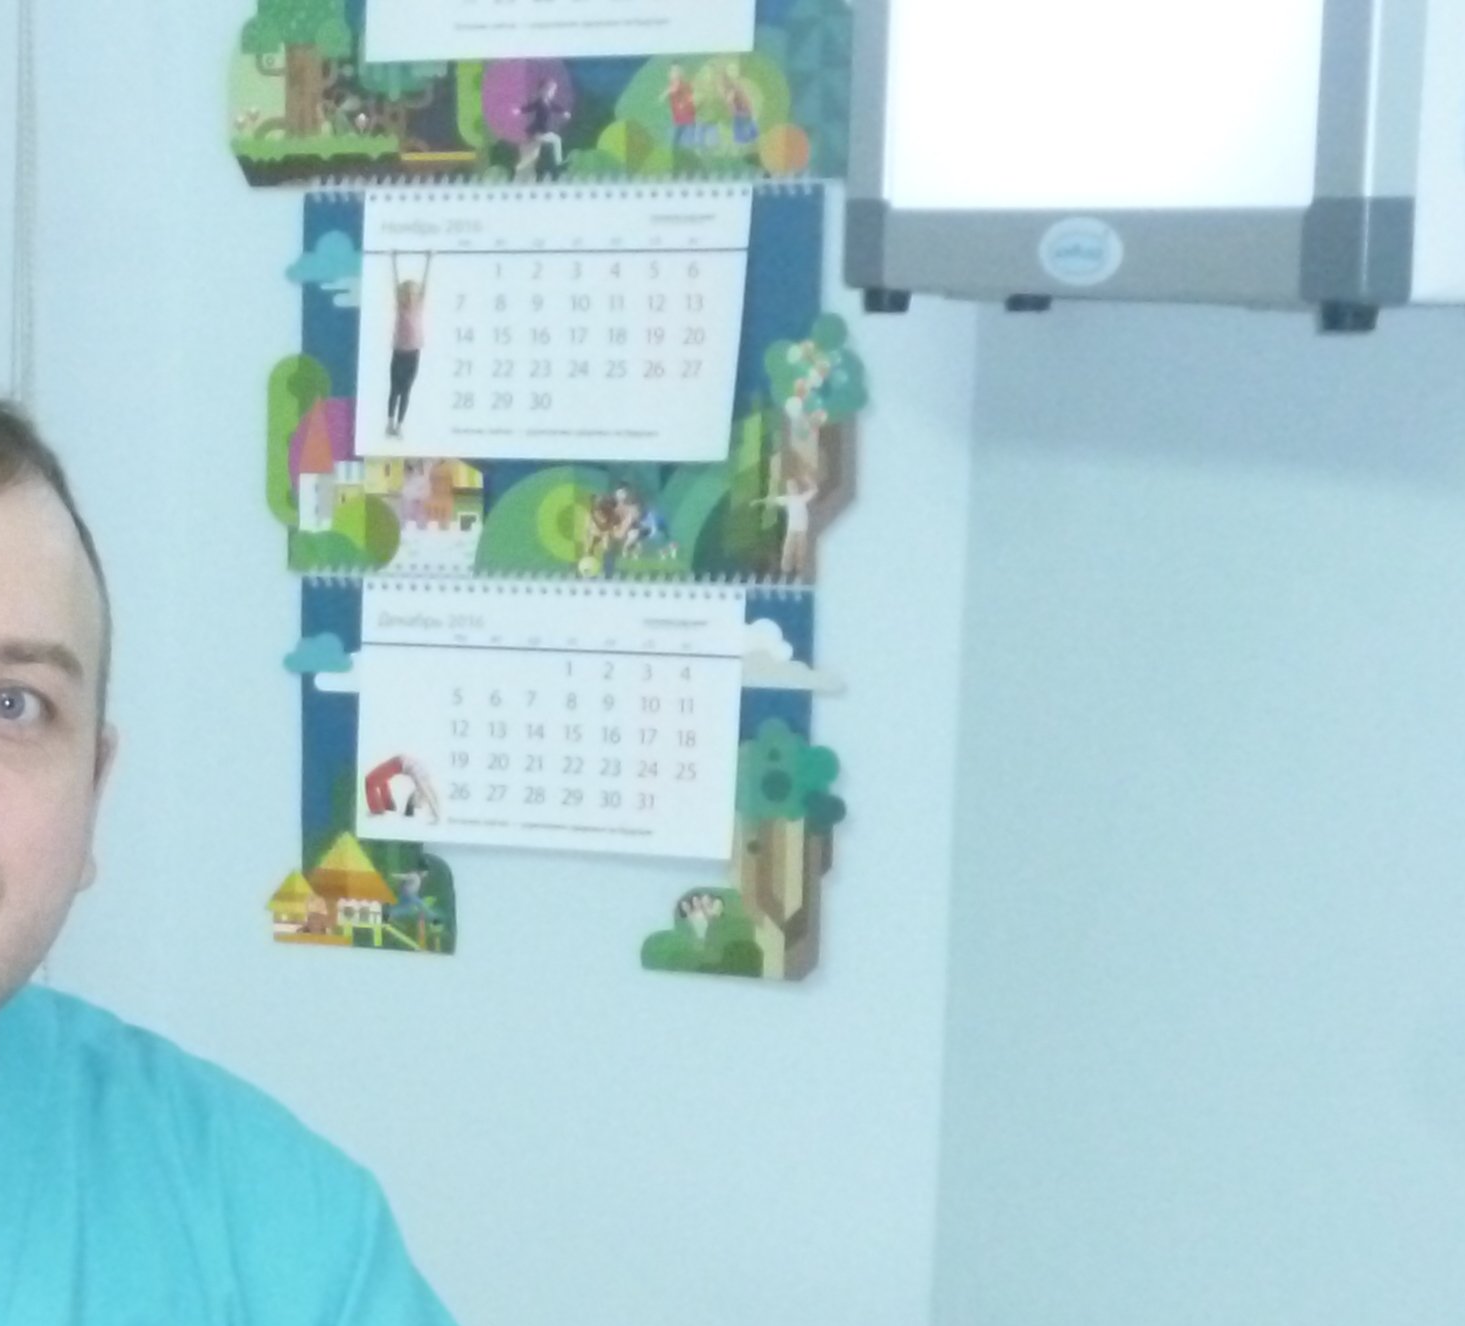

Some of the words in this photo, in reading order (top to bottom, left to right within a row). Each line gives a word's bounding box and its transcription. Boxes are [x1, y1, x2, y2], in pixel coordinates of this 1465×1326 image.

[494, 261, 504, 279] 1
[531, 260, 543, 280] 2
[571, 261, 582, 280] 3
[610, 262, 620, 278] 4
[649, 260, 660, 279] 5
[687, 261, 700, 279] 6
[455, 293, 466, 312] 7
[494, 294, 507, 312] 8
[531, 294, 544, 312] 9
[570, 294, 591, 312] 10
[608, 294, 625, 312] 11
[648, 294, 666, 312] 12
[686, 294, 703, 312] 13
[456, 327, 474, 343] 14
[493, 326, 512, 345] 15
[530, 327, 551, 345] 16
[569, 326, 588, 344] 17
[608, 327, 627, 345] 18
[646, 327, 665, 345] 19
[683, 327, 706, 345] 20
[453, 358, 473, 378] 21
[492, 359, 514, 379] 22
[529, 359, 552, 378] 23
[568, 360, 589, 378] 24
[605, 360, 627, 379] 25
[643, 360, 665, 379] 26
[681, 360, 702, 379] 27
[452, 391, 474, 410] 28
[491, 391, 513, 410] 29
[530, 392, 552, 410] 30
[564, 659, 574, 677] 1
[603, 661, 614, 680] 2
[643, 663, 653, 681] 3
[680, 666, 691, 681] 4
[452, 687, 463, 706] 5
[489, 690, 502, 707] 6
[526, 690, 537, 707] 7
[566, 692, 577, 710] 8
[602, 694, 615, 711] 9
[641, 696, 661, 714] 10
[679, 698, 694, 713] 11
[451, 719, 469, 738] 12
[489, 721, 507, 739] 13
[527, 724, 545, 739] 14
[564, 724, 582, 743] 15
[602, 726, 621, 745] 16
[639, 728, 658, 744] 17
[678, 730, 696, 748] 18
[451, 752, 469, 768] 19
[487, 753, 510, 771] 20
[525, 754, 543, 772] 21
[562, 755, 584, 775] 22
[599, 758, 622, 777] 23
[637, 760, 658, 778] 24
[675, 762, 697, 781] 25
[449, 782, 471, 800] 26
[486, 784, 508, 802] 27
[524, 786, 545, 804] 28
[561, 788, 583, 806] 29
[601, 790, 622, 809] 30
[638, 792, 655, 810] 31
